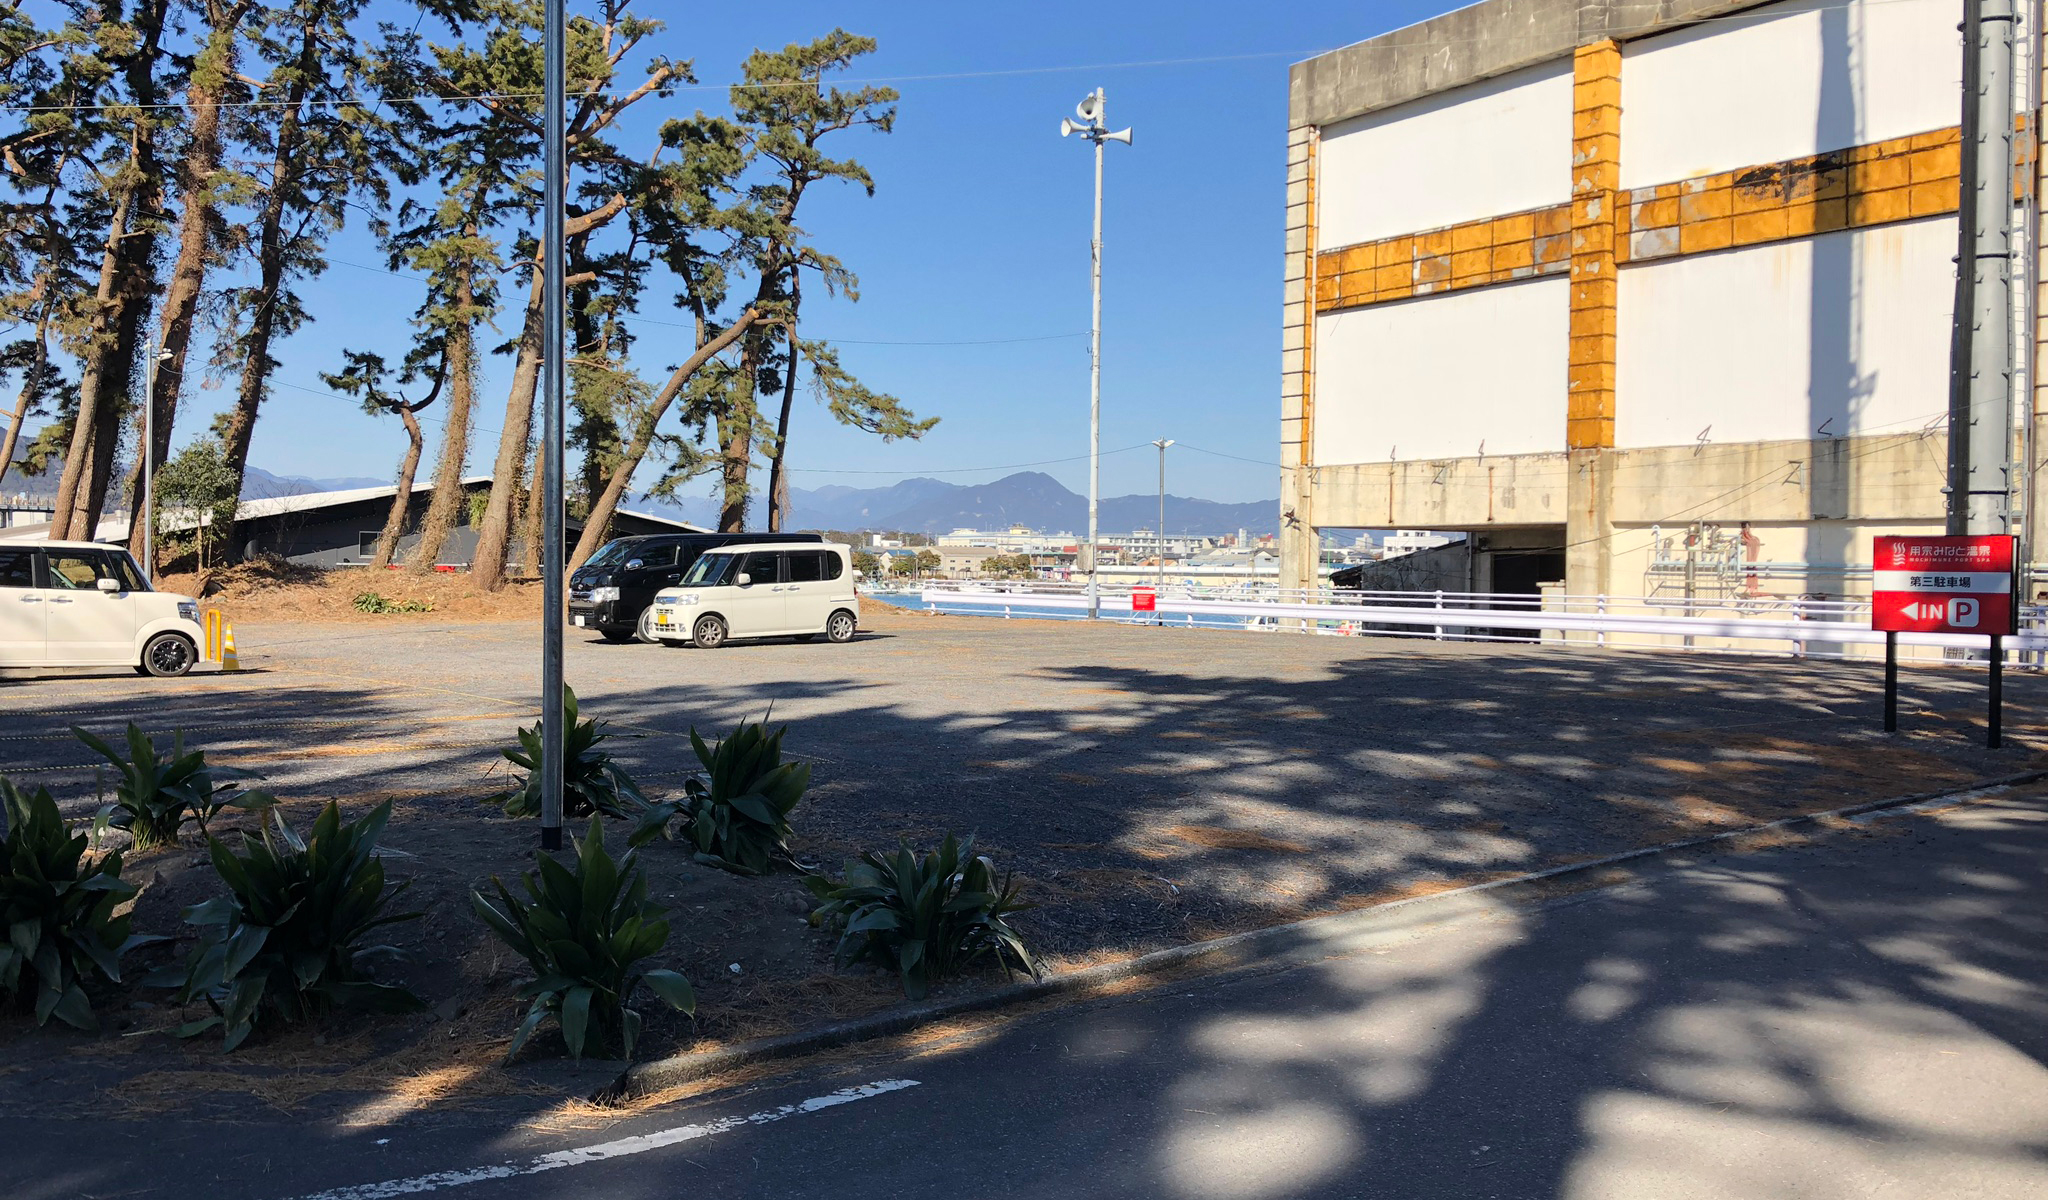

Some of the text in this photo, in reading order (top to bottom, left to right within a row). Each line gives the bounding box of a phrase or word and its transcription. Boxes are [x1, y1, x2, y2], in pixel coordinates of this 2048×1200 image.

[1909, 545, 1990, 556] 用宗みなと温泉
[1909, 576, 1971, 588] 第三駐車場
[1921, 602, 1972, 622] IN P
